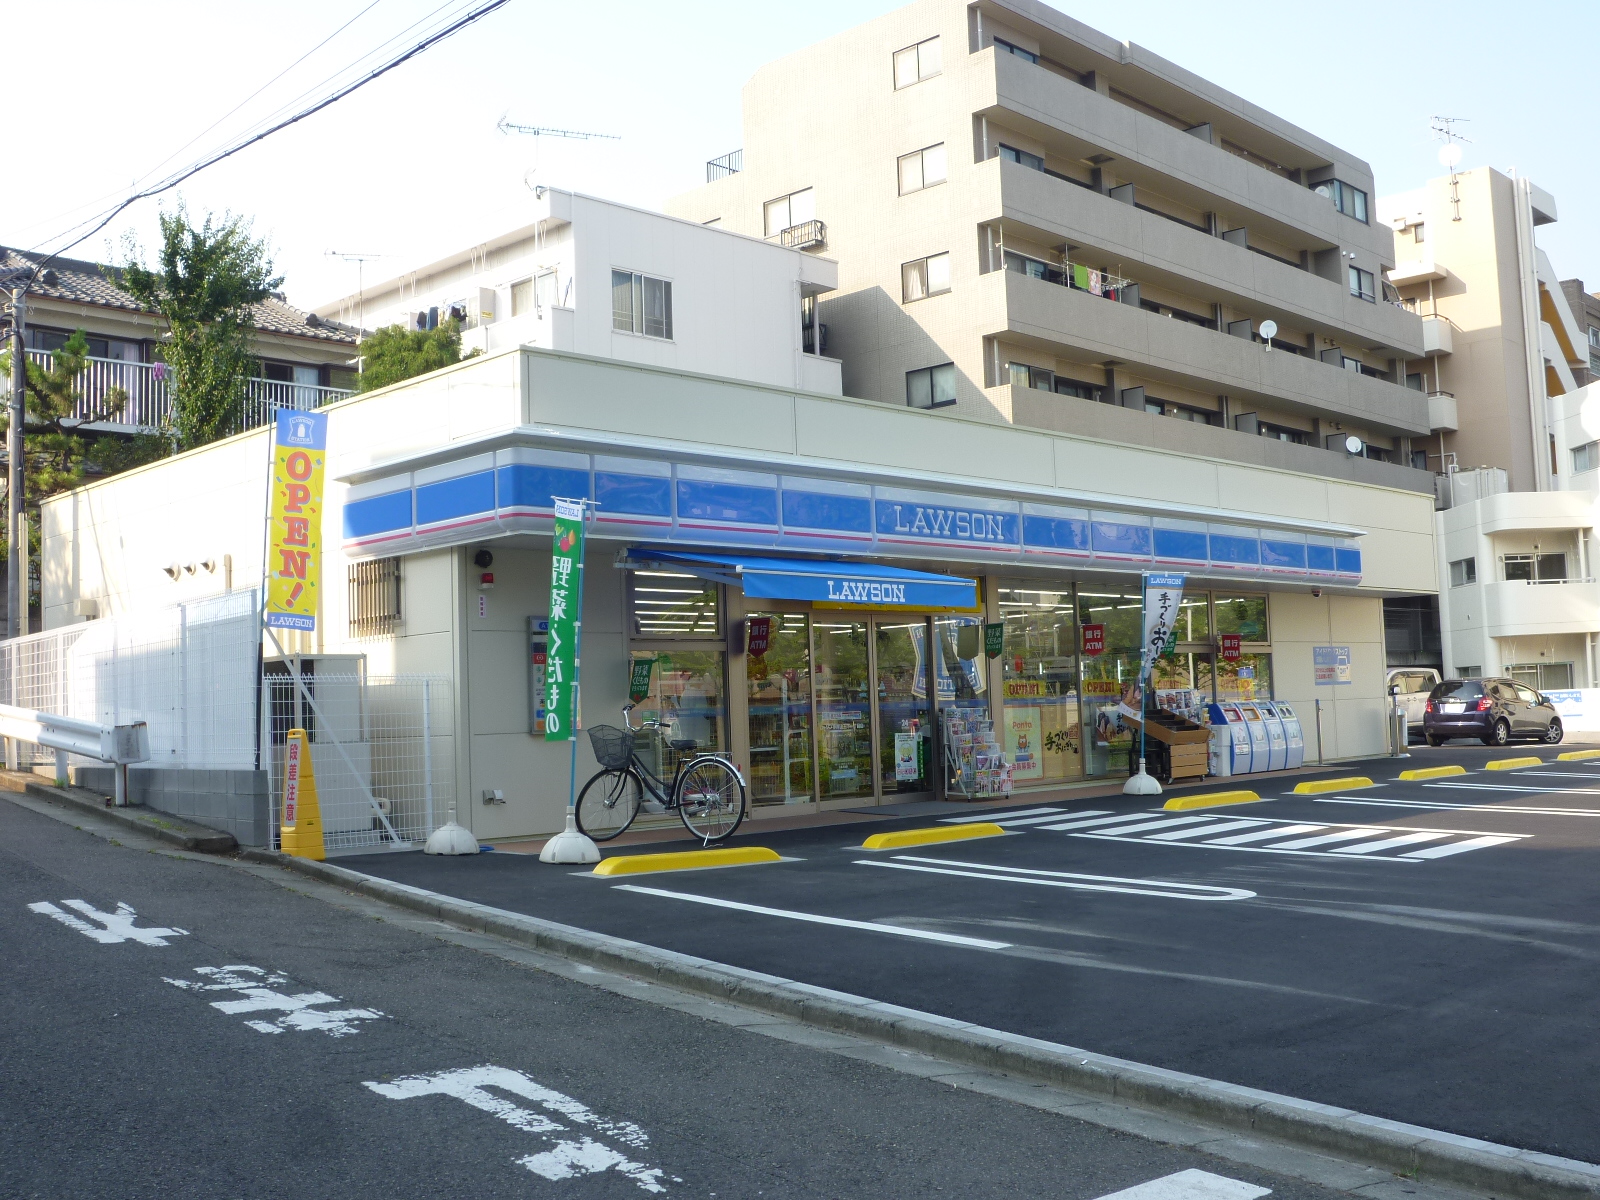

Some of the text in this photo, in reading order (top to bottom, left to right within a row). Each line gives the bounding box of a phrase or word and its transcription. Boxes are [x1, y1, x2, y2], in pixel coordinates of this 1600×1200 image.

[894, 505, 1005, 540] LAWSON
[278, 451, 313, 608] OPEN!
[1151, 577, 1182, 585] LAWSON
[828, 580, 906, 602] LAWSON
[270, 616, 313, 628] LAWSON
[752, 625, 767, 636] 銀行
[1085, 629, 1101, 639] 銀行
[750, 640, 767, 649] ATM
[1085, 642, 1102, 650] ATM
[1223, 639, 1238, 648] 銀行
[634, 665, 649, 676] 野菜
[286, 743, 299, 822] 段差注意
